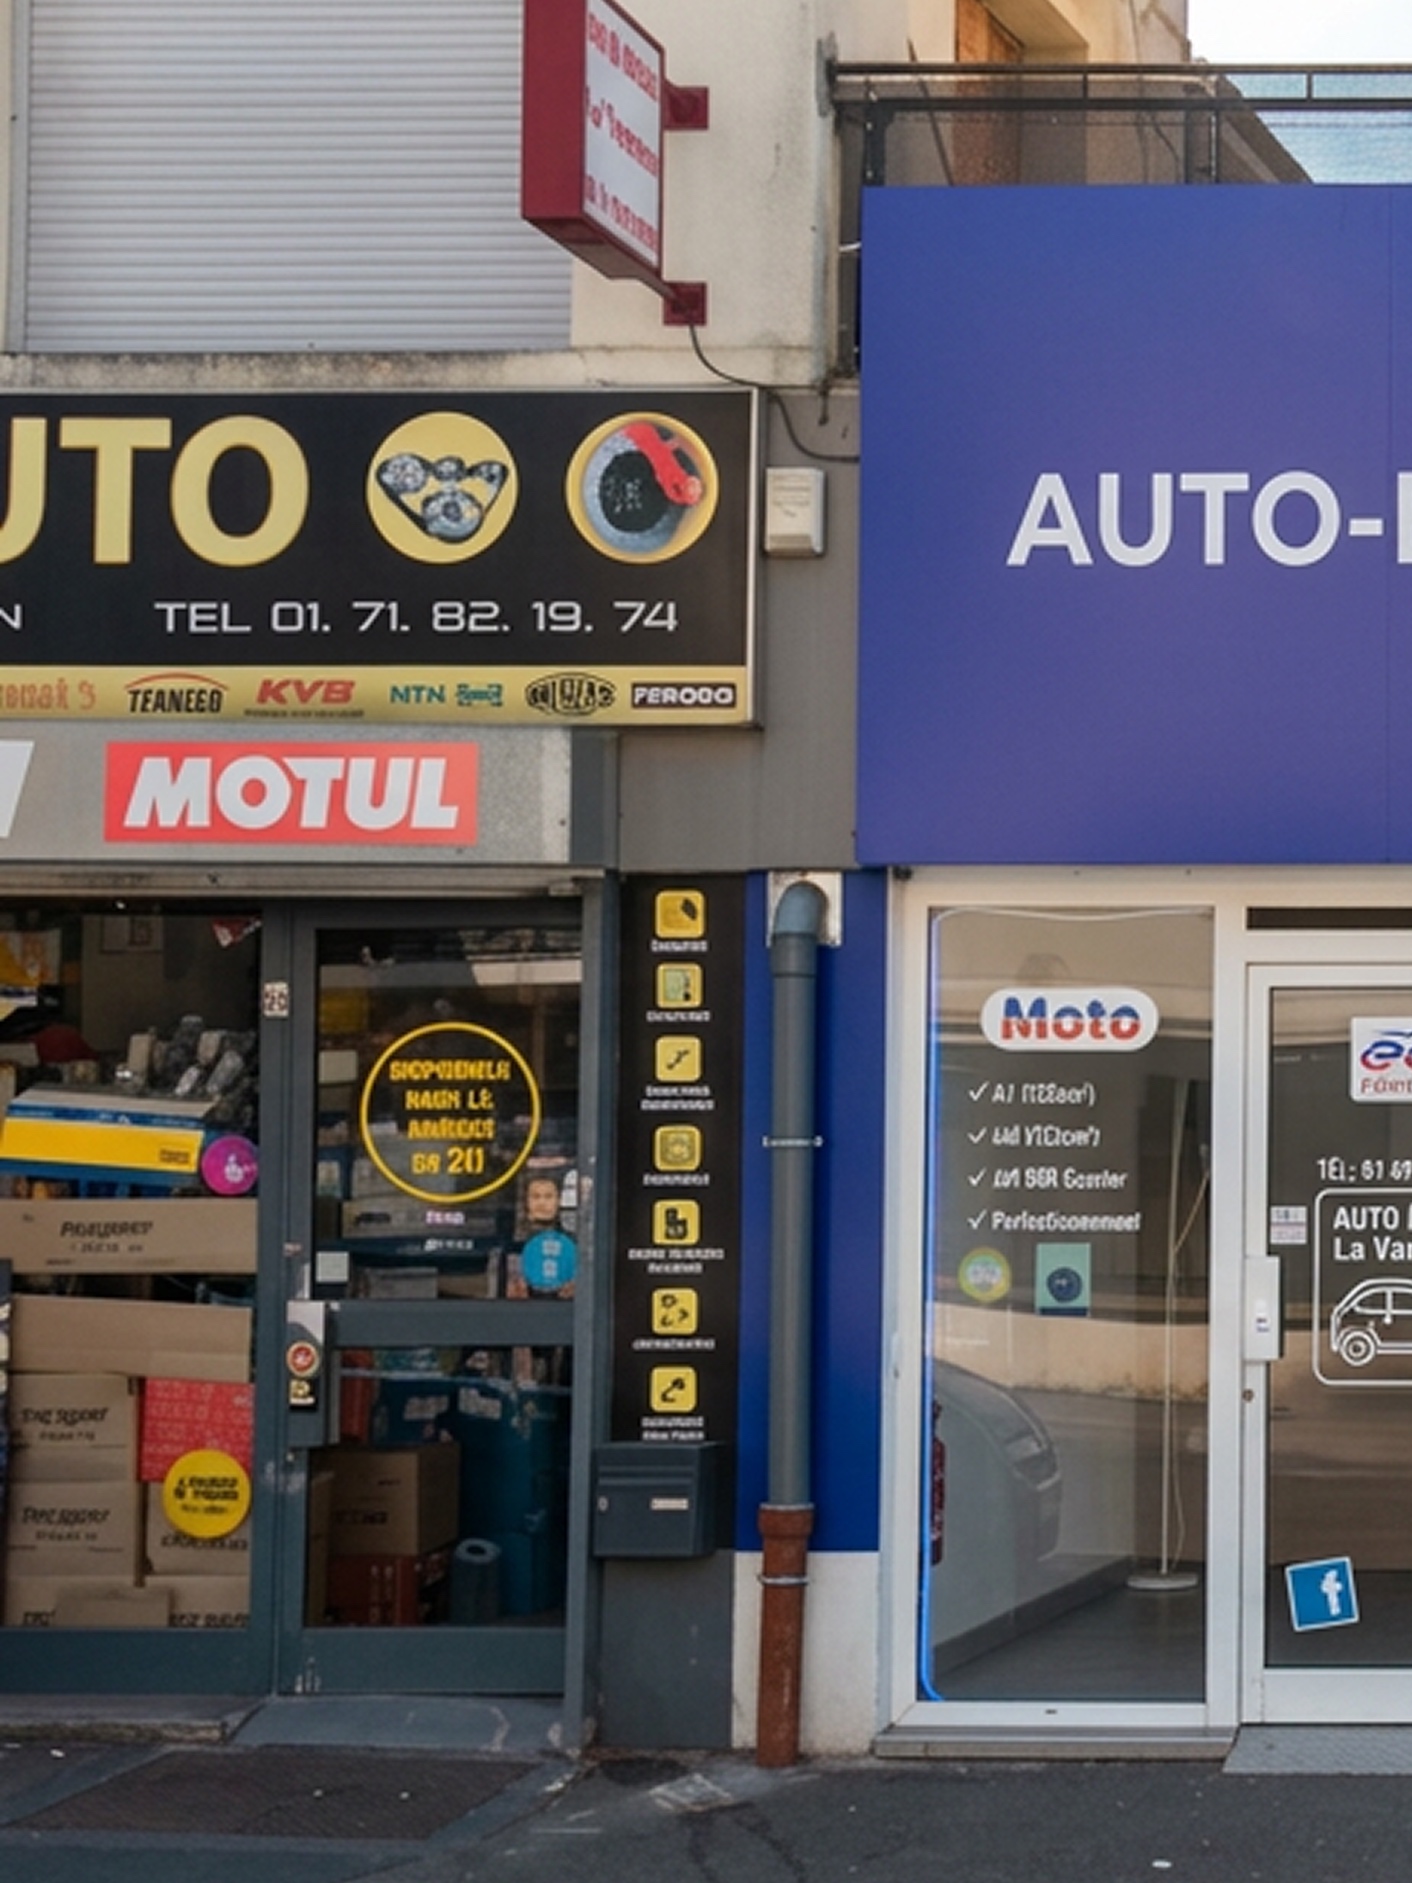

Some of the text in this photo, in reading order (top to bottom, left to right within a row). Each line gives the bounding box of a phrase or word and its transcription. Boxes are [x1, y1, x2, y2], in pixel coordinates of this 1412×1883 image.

[154, 602, 678, 632] TEL 01. 71. 82. 19. 74
[390, 685, 446, 704] NTN
[123, 754, 458, 830] MOTUL
[1002, 996, 1140, 1041] Moto
[1333, 1205, 1400, 1231] AUTO
[1334, 1236, 1365, 1261] La
